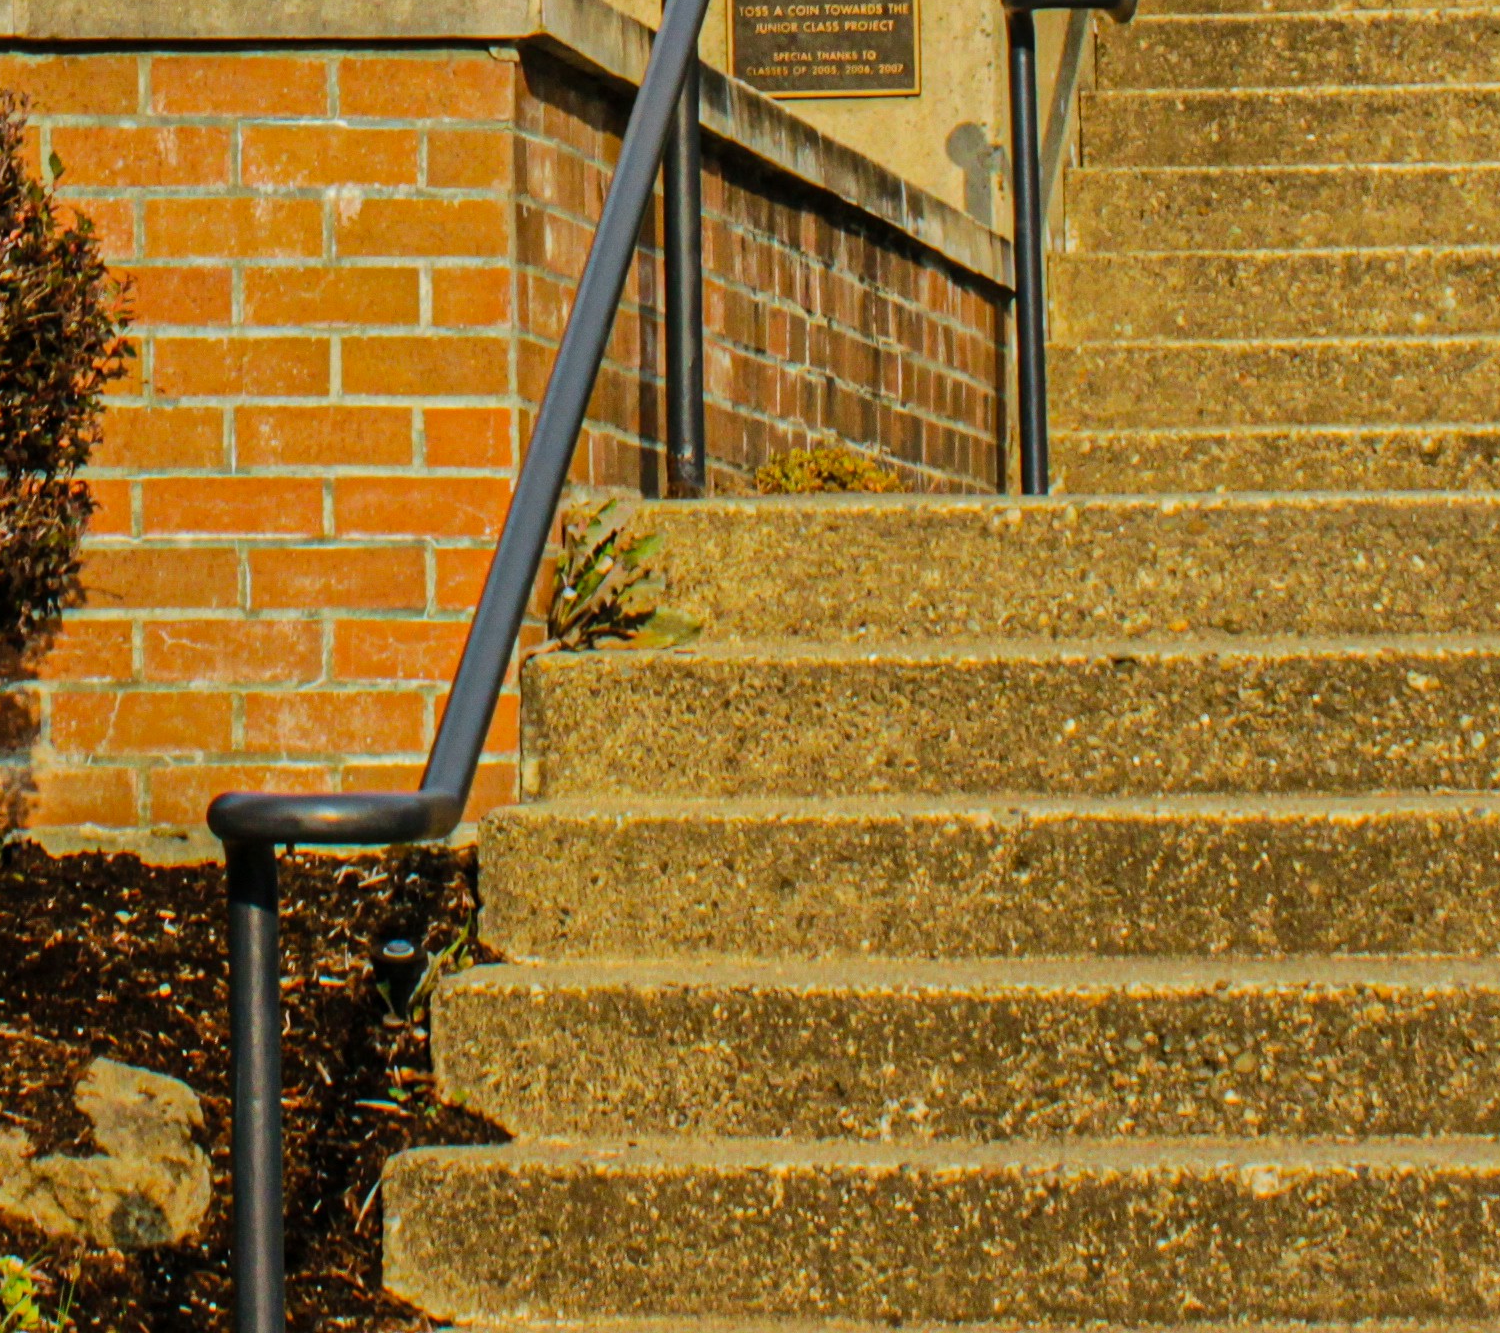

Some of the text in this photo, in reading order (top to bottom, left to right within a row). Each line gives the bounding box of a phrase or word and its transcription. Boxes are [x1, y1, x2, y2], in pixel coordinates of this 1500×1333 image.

[739, 2, 910, 18] TOSS A COIN TOWARDS THE
[755, 19, 895, 34] JUNIOR CLASS PROJECT
[773, 49, 877, 62] SPECIAL THANKS TO
[746, 66, 789, 77] CLASSES
[792, 65, 808, 77] OF
[878, 63, 904, 75] 2007
